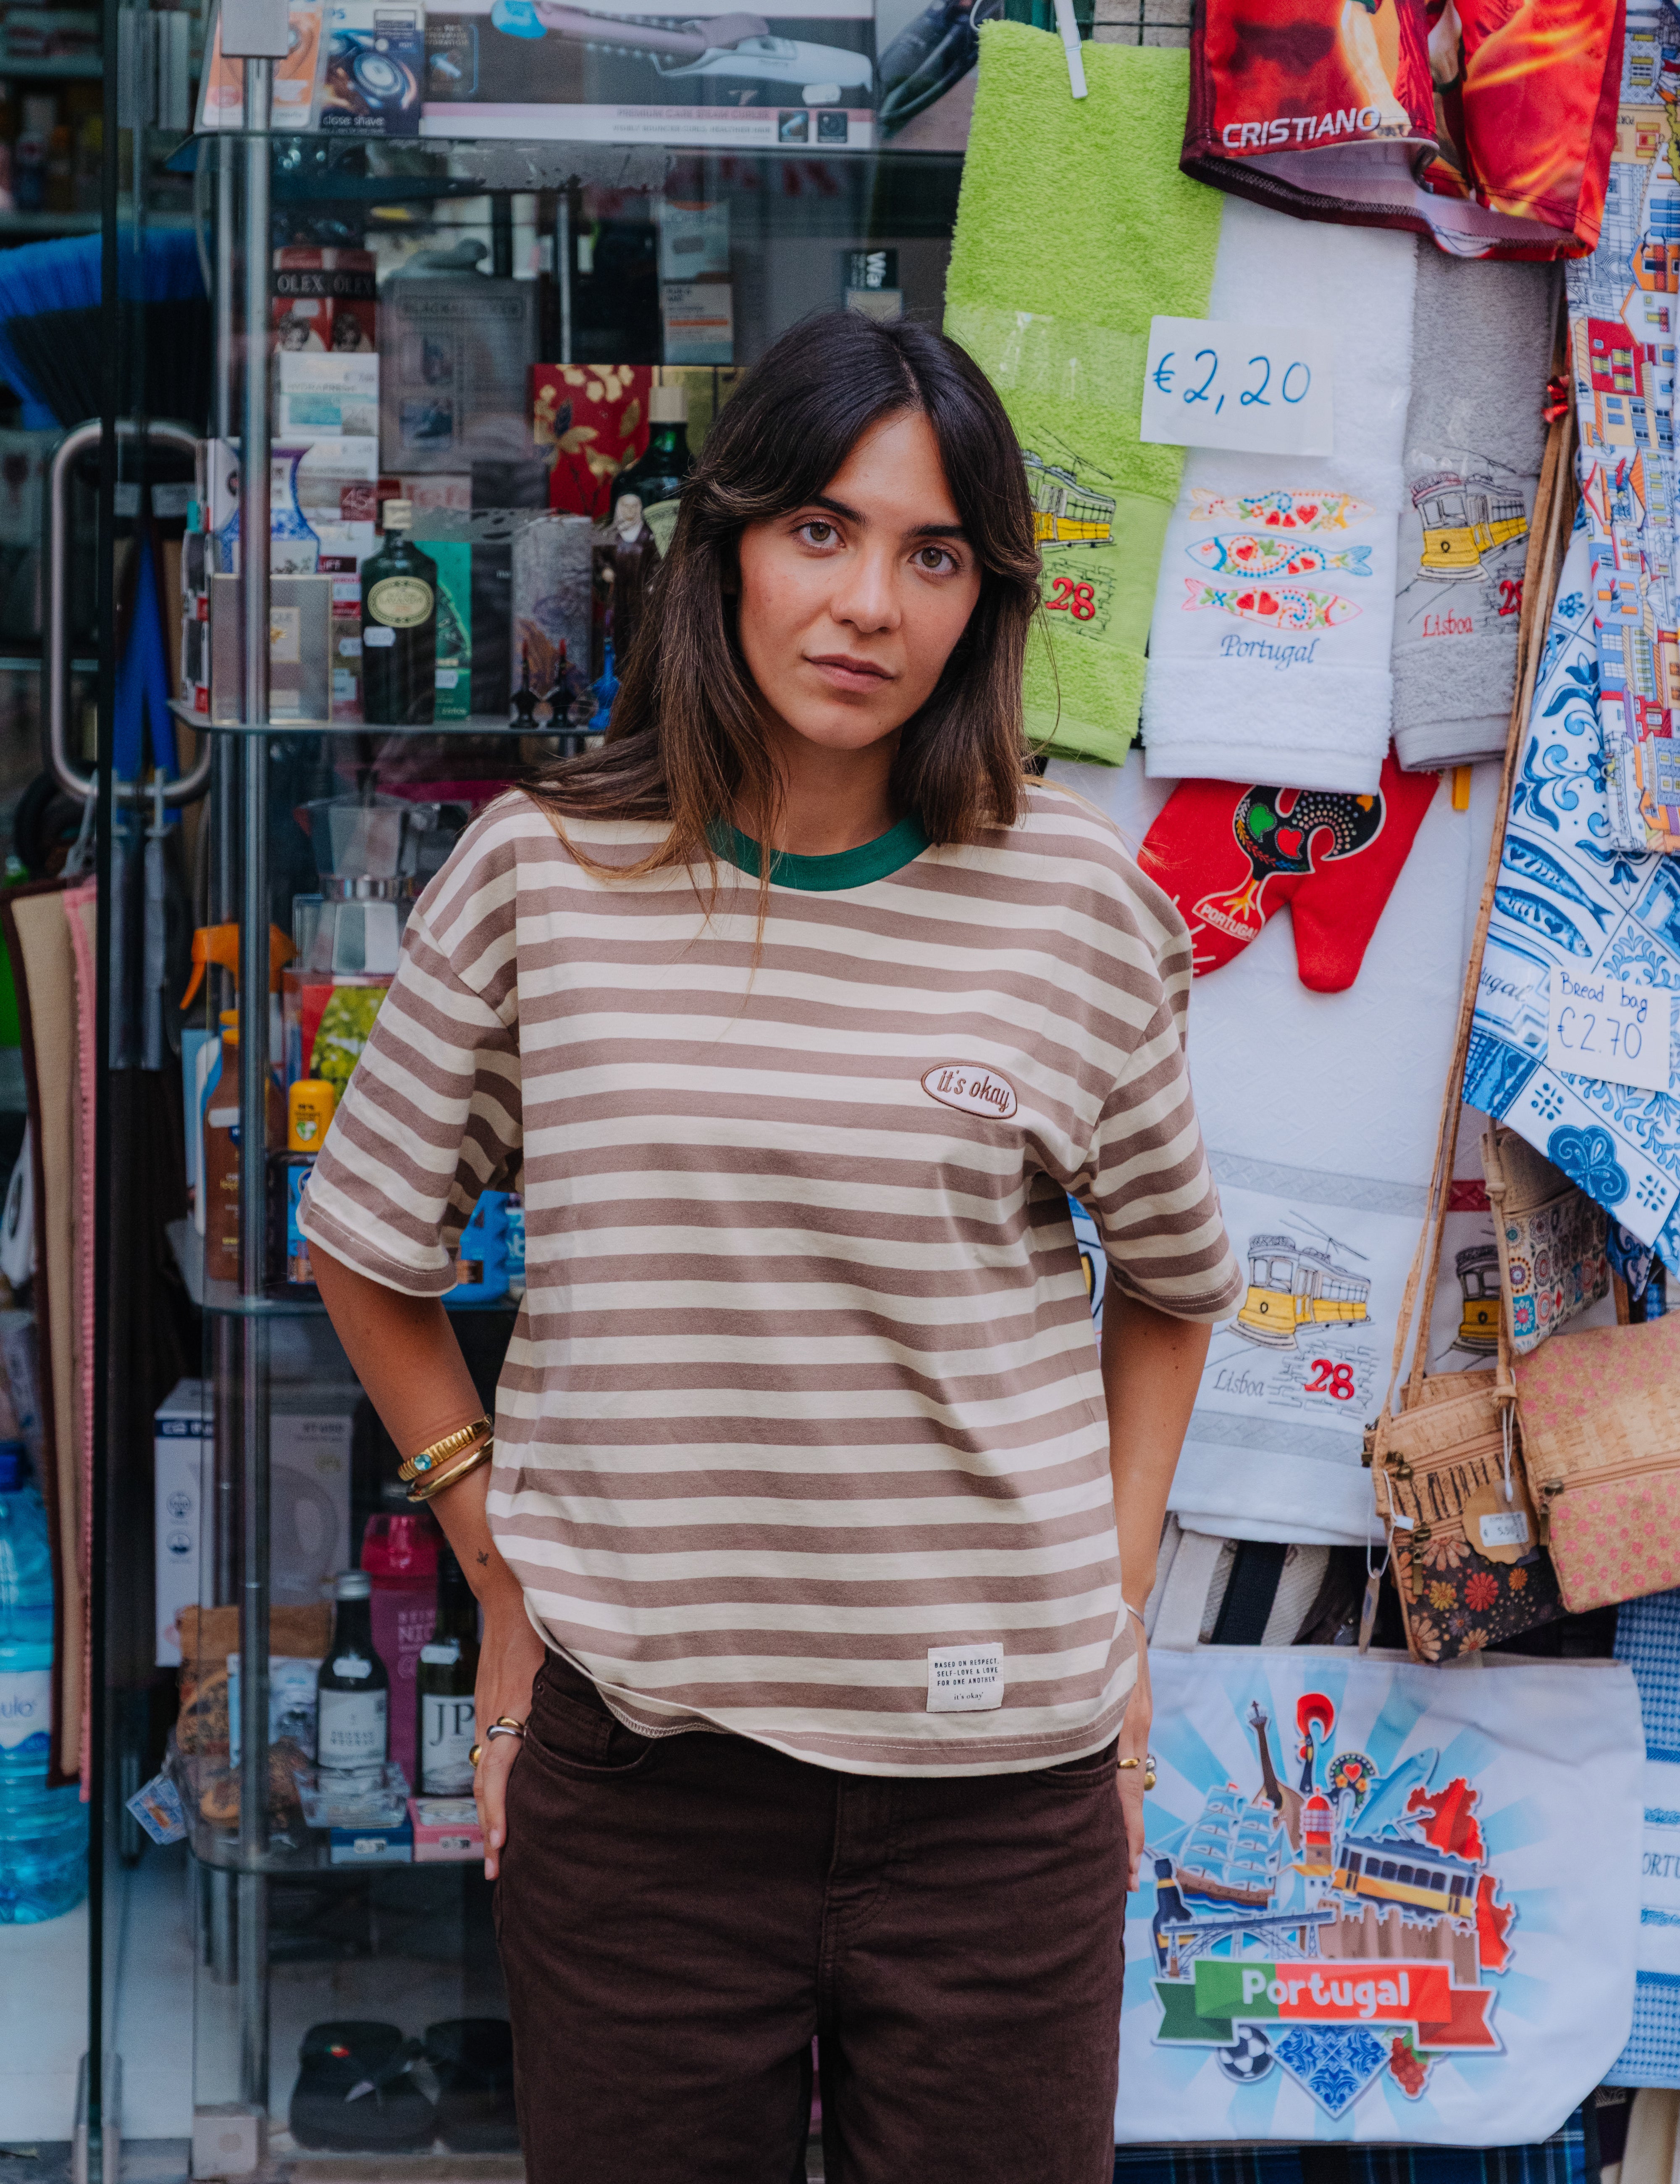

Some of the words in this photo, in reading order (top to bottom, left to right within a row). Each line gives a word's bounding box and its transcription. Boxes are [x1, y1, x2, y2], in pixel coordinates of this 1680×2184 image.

[323, 116, 352, 126] close
[354, 116, 386, 126] shave
[1223, 106, 1381, 149] CRISTIANO
[277, 274, 324, 292] OLEX
[1045, 577, 1095, 620] 28
[1422, 608, 1473, 638] Lisboa
[1220, 634, 1320, 672] Portugal
[1560, 972, 1604, 1003] Bread
[1621, 986, 1648, 1023] bag
[969, 1075, 1009, 1113] okay
[1213, 1368, 1264, 1397] Lisboa
[1304, 1359, 1354, 1400] 28
[937, 1669, 973, 1677] SELF-LOVE
[429, 1703, 475, 1746] JP
[1242, 1968, 1410, 2018] Portugal
